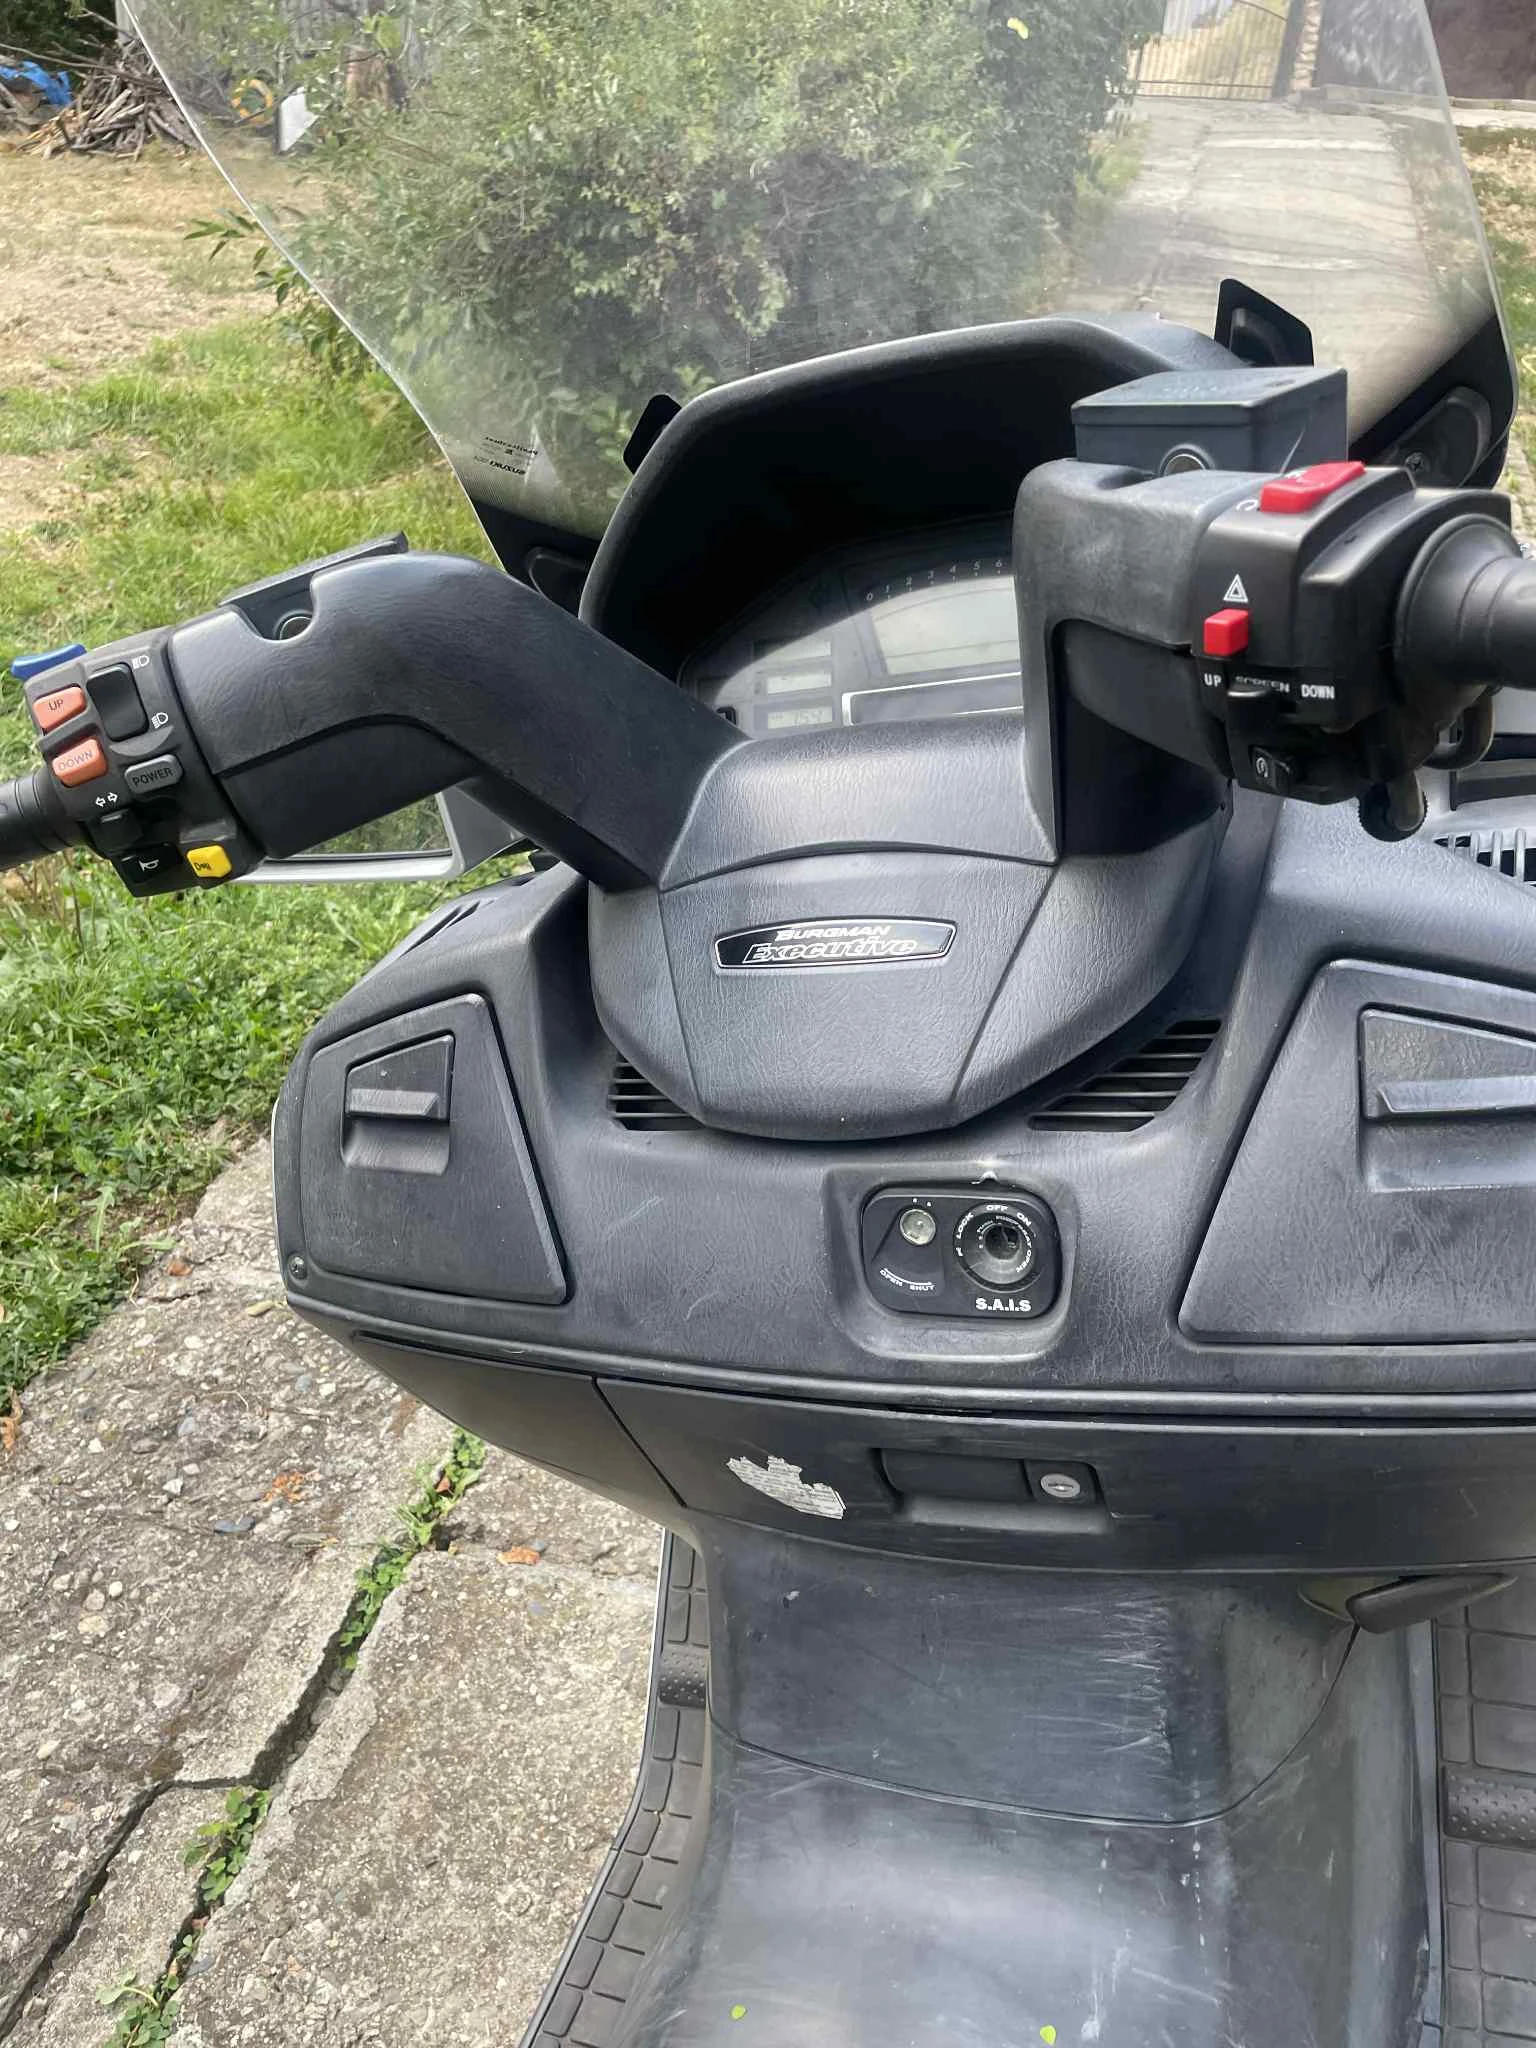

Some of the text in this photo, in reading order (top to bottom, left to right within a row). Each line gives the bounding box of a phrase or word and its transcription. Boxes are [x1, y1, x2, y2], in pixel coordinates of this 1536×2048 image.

[905, 576, 913, 585] 2
[927, 570, 935, 580] 3
[973, 561, 980, 570] 5
[995, 559, 1003, 568] 6
[1204, 673, 1222, 687] UP
[1301, 683, 1335, 699] DOWN
[48, 698, 64, 711] UP
[58, 750, 93, 771] DOWN
[132, 767, 174, 787] POWER
[775, 925, 891, 942] BURGMAN
[742, 936, 917, 964] Executive
[986, 1204, 1009, 1212] OFF
[956, 1212, 974, 1239] LOCK
[1016, 1212, 1032, 1226] ON
[880, 1269, 903, 1286] OPEN
[975, 1297, 1032, 1312] S.A.I.S
